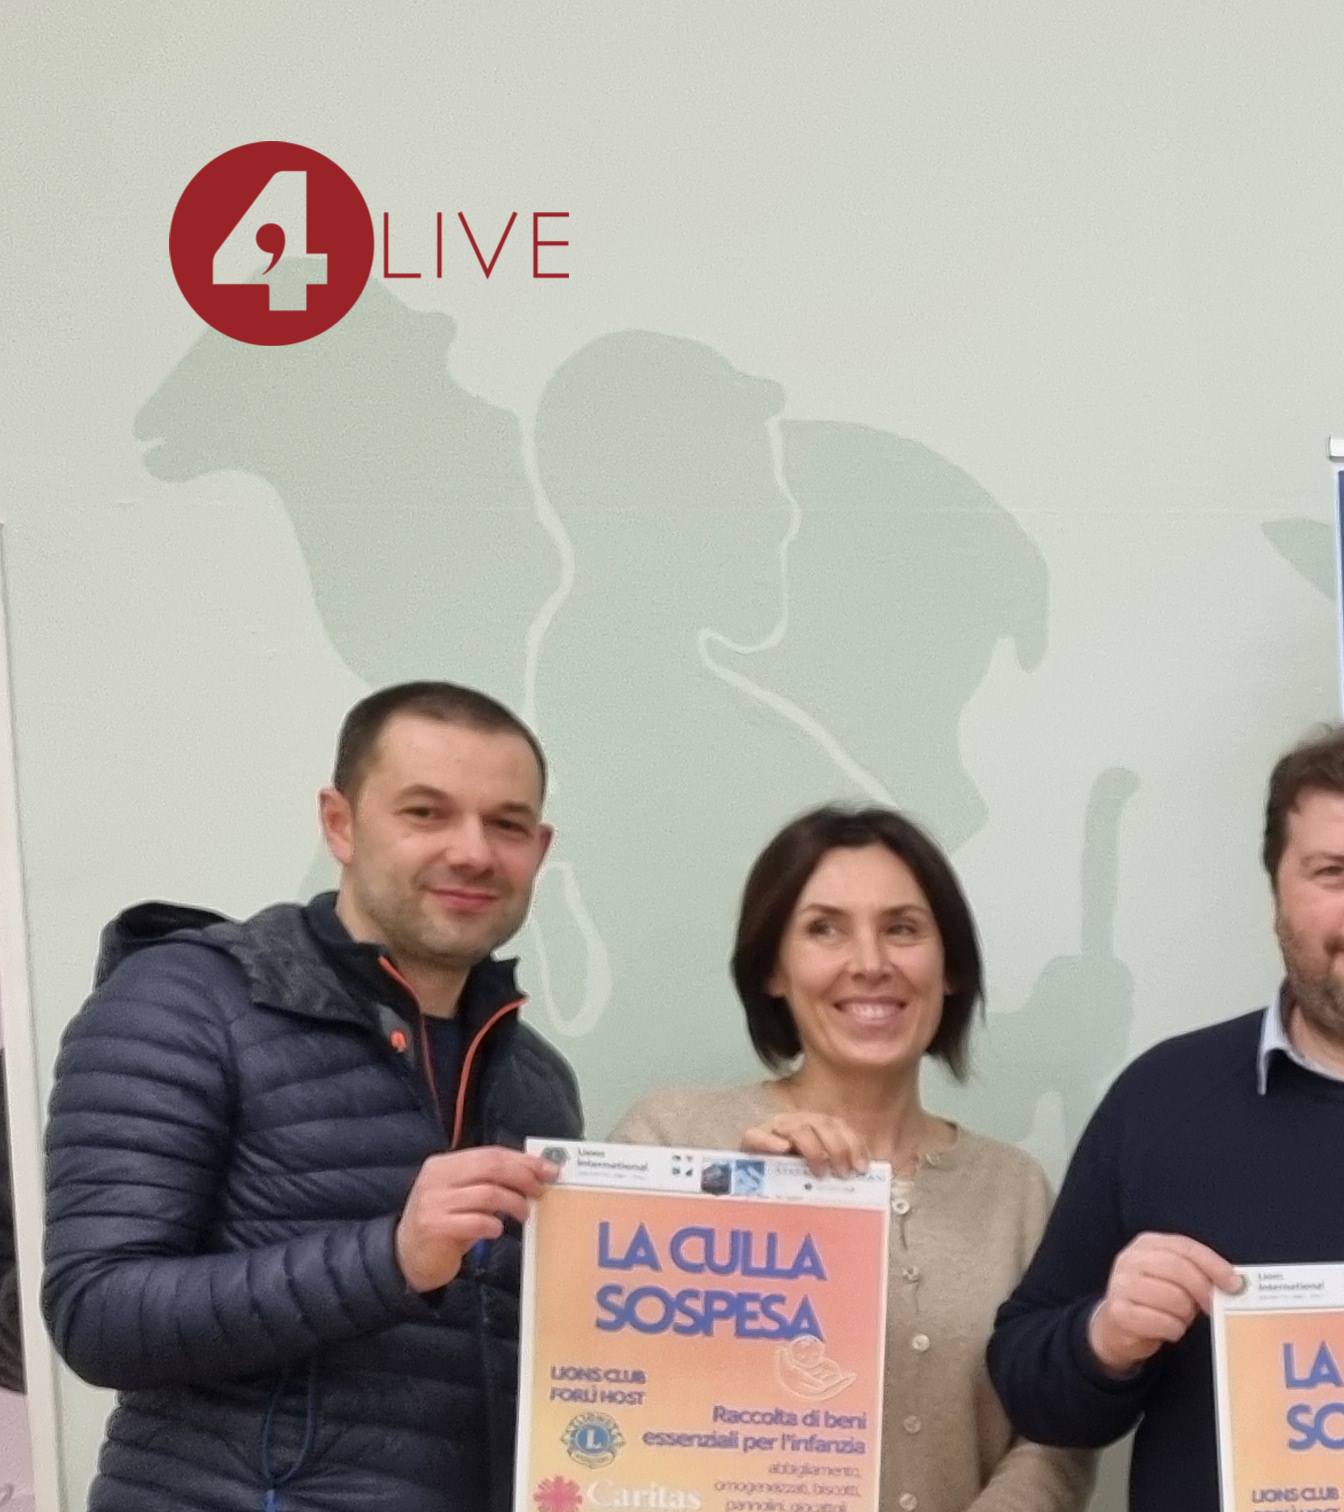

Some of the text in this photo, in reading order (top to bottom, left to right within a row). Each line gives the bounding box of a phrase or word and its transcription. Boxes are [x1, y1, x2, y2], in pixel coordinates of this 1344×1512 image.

[598, 1220, 828, 1281] LA CULLA
[596, 1284, 825, 1343] SOSPESA
[1282, 1341, 1344, 1389] LA
[712, 1405, 866, 1429] Raccolta di beni
[643, 1430, 739, 1449] essenziali
[742, 1435, 778, 1454] per
[588, 1479, 699, 1509] Caritas
[1251, 1486, 1340, 1502] LIONS CLUB
